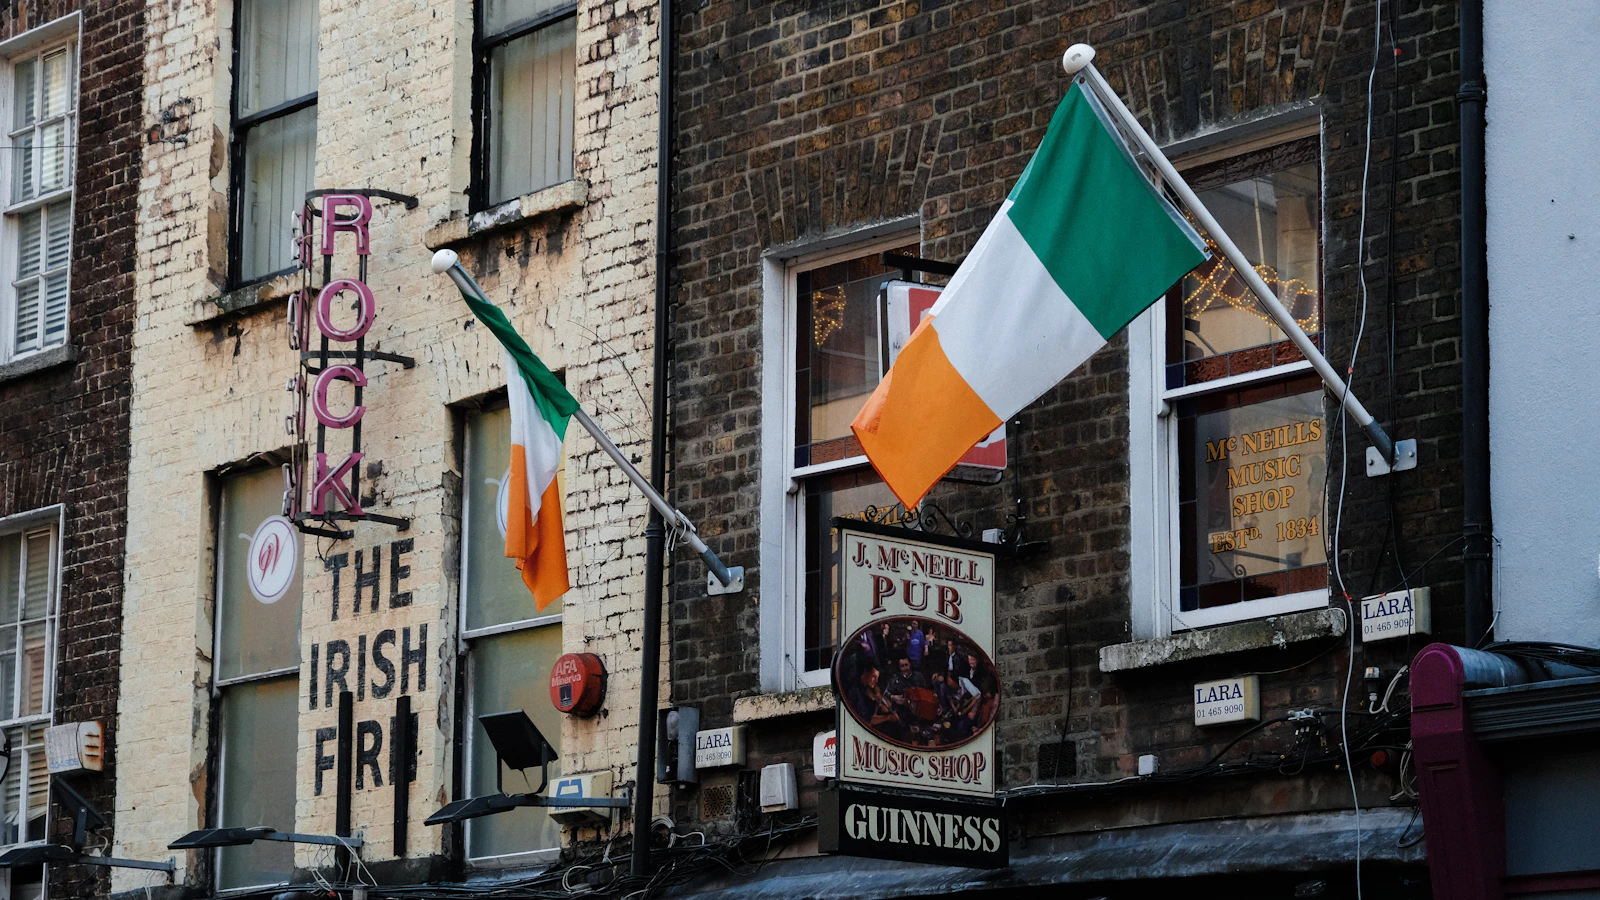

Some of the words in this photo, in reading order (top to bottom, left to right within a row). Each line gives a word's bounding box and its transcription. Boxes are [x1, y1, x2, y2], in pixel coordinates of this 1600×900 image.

[311, 194, 375, 515] ROCK
[1227, 454, 1301, 489] MUSIC
[1233, 485, 1295, 517] SHOP
[1276, 515, 1318, 542] 1834
[852, 542, 871, 569] J.
[324, 537, 414, 621] THE
[869, 573, 963, 624] PUB
[1363, 596, 1414, 620] LARA
[1364, 625, 1374, 635] 01
[1377, 622, 1392, 631] 465
[1394, 617, 1415, 629] 9090
[309, 623, 427, 710] IRISH
[551, 673, 582, 687] Minerva
[555, 659, 577, 677] AFA
[1196, 683, 1243, 704] LARA
[1197, 709, 1206, 718] 01
[1208, 706, 1222, 716] 465
[1224, 703, 1244, 714] 9090
[697, 732, 732, 750] LARA
[705, 753, 716, 761] 465
[852, 735, 924, 778] MUSIC
[927, 752, 986, 785] SHOP
[845, 804, 1000, 853] GUINNESS
